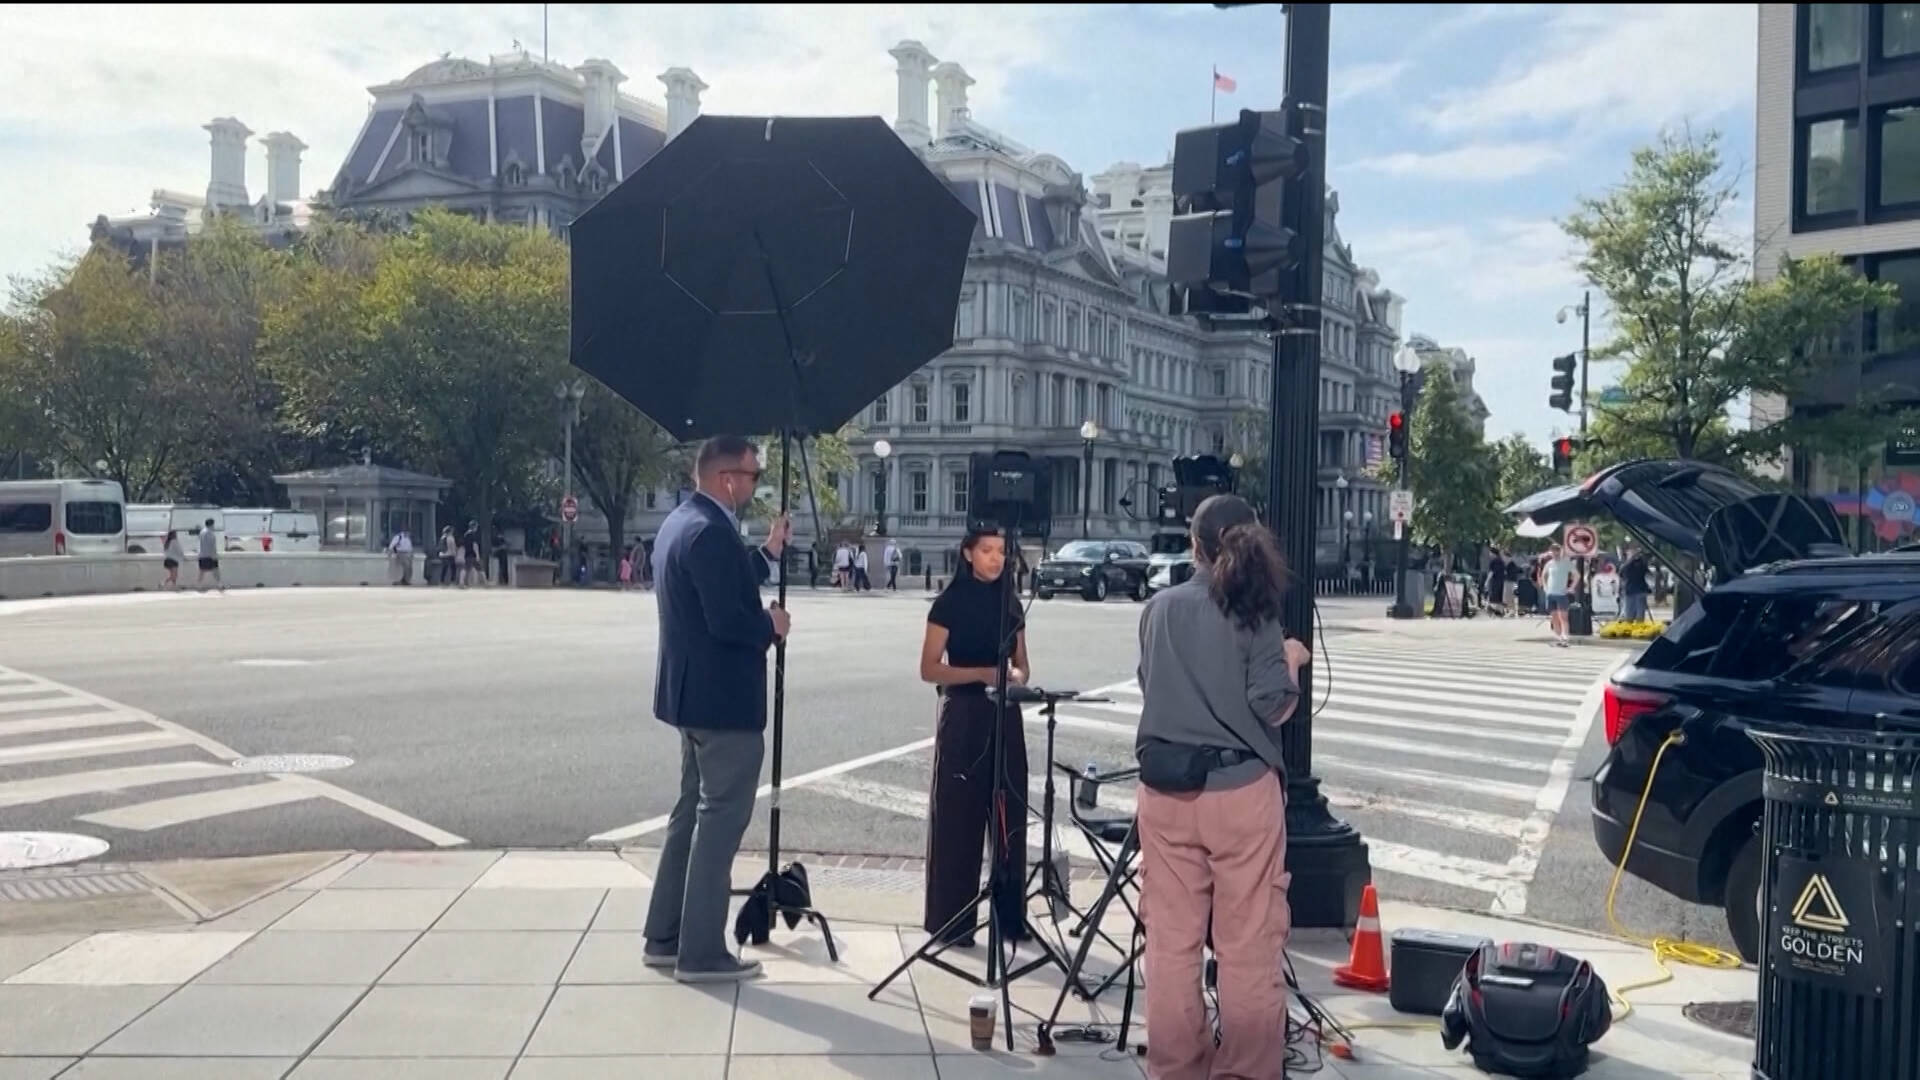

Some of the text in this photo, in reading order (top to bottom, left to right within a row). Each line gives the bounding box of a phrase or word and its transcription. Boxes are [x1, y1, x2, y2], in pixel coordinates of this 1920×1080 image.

[1781, 935, 1863, 964] GOLDEN
[1782, 926, 1864, 948] KEEP THE STREETS
